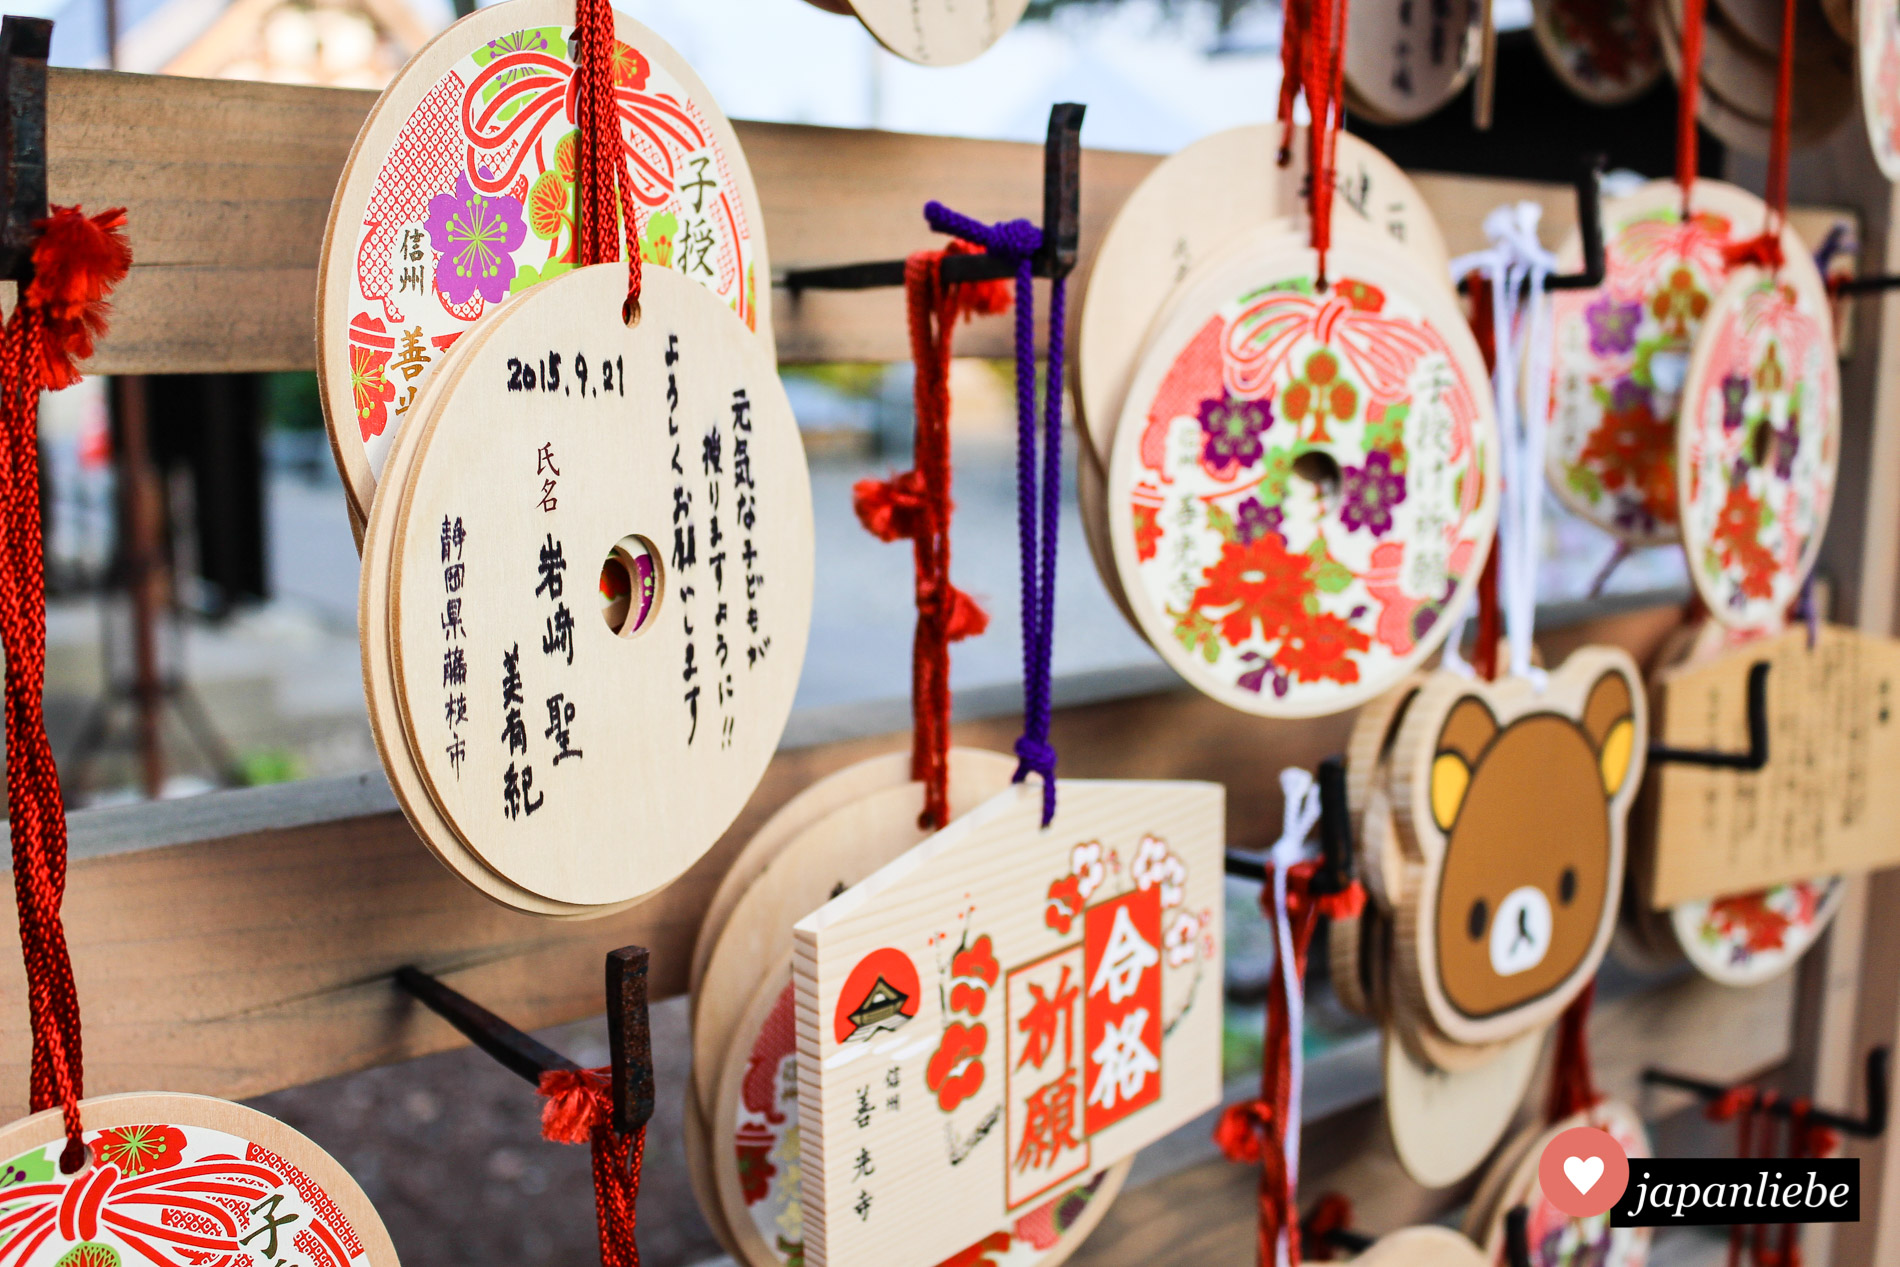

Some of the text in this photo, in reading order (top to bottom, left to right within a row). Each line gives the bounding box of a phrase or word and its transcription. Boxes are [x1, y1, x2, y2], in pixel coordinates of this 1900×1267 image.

[677, 157, 716, 286] 子授
[399, 228, 425, 296] 信州
[507, 350, 624, 398] 2015.9.21
[536, 441, 561, 513] 氏名
[665, 334, 700, 746] よろしくお願いします
[545, 692, 583, 767] 聖
[1088, 904, 1160, 1111] 合格
[885, 1065, 902, 1113] 信州
[1014, 964, 1081, 1176] 祈願
[851, 1084, 876, 1222] 善光寺
[238, 1194, 300, 1267] 子
